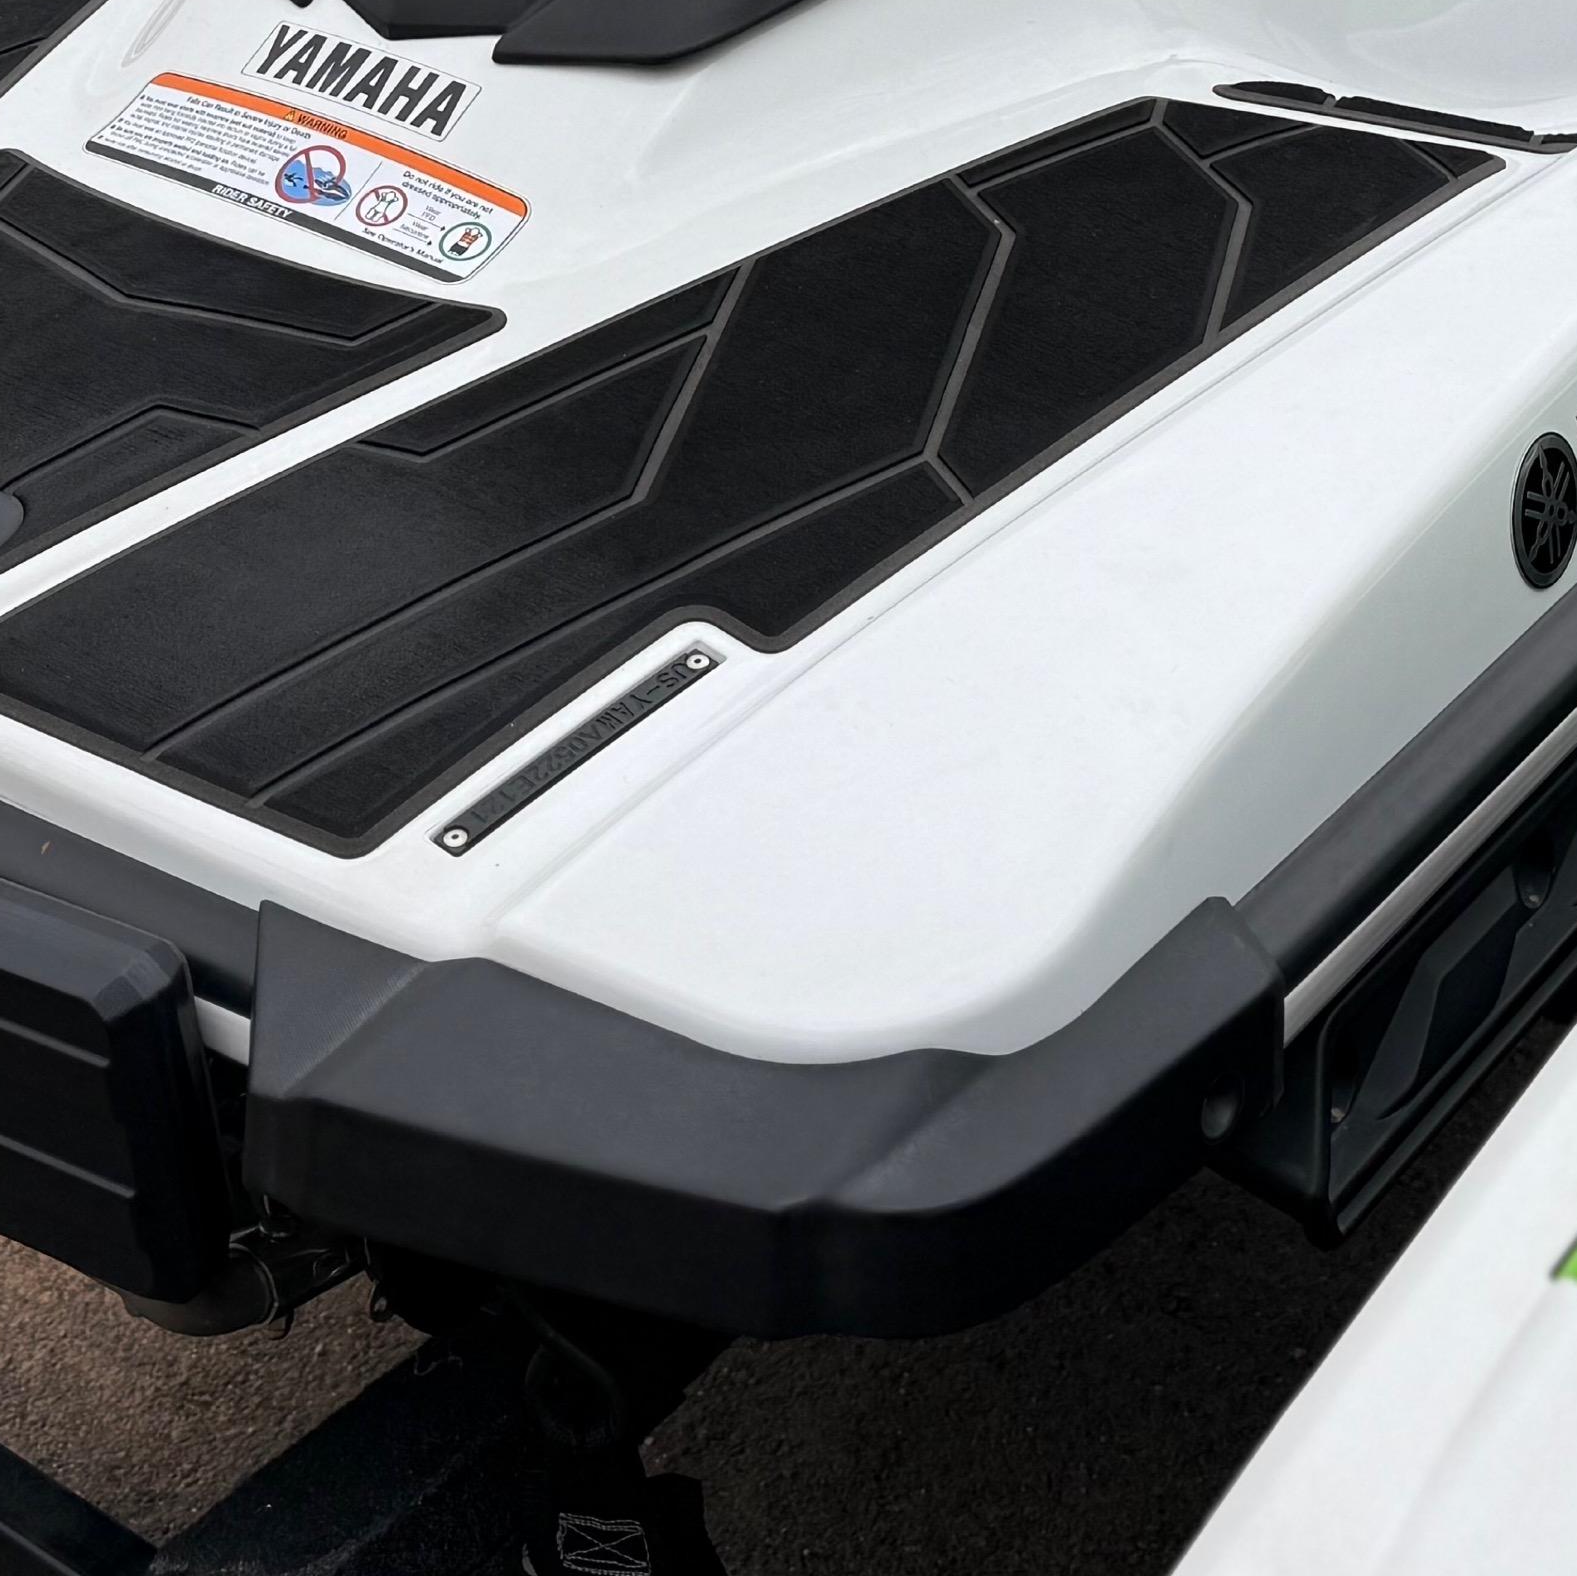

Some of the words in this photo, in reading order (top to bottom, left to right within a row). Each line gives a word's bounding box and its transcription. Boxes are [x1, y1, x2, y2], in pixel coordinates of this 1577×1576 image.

[256, 23, 467, 137] YAMAHA
[201, 100, 214, 108] Can
[215, 103, 234, 114] Result
[241, 111, 263, 123] Severe
[264, 118, 282, 131] Injury
[297, 113, 348, 140] WARNING
[211, 184, 248, 203] RIDER
[247, 196, 293, 218] SAFETY
[403, 170, 415, 180] Do
[415, 178, 429, 186] not
[428, 182, 445, 192] ride
[450, 192, 466, 202] you
[465, 199, 479, 208] are
[479, 205, 493, 214] not
[416, 249, 444, 264] Manual
